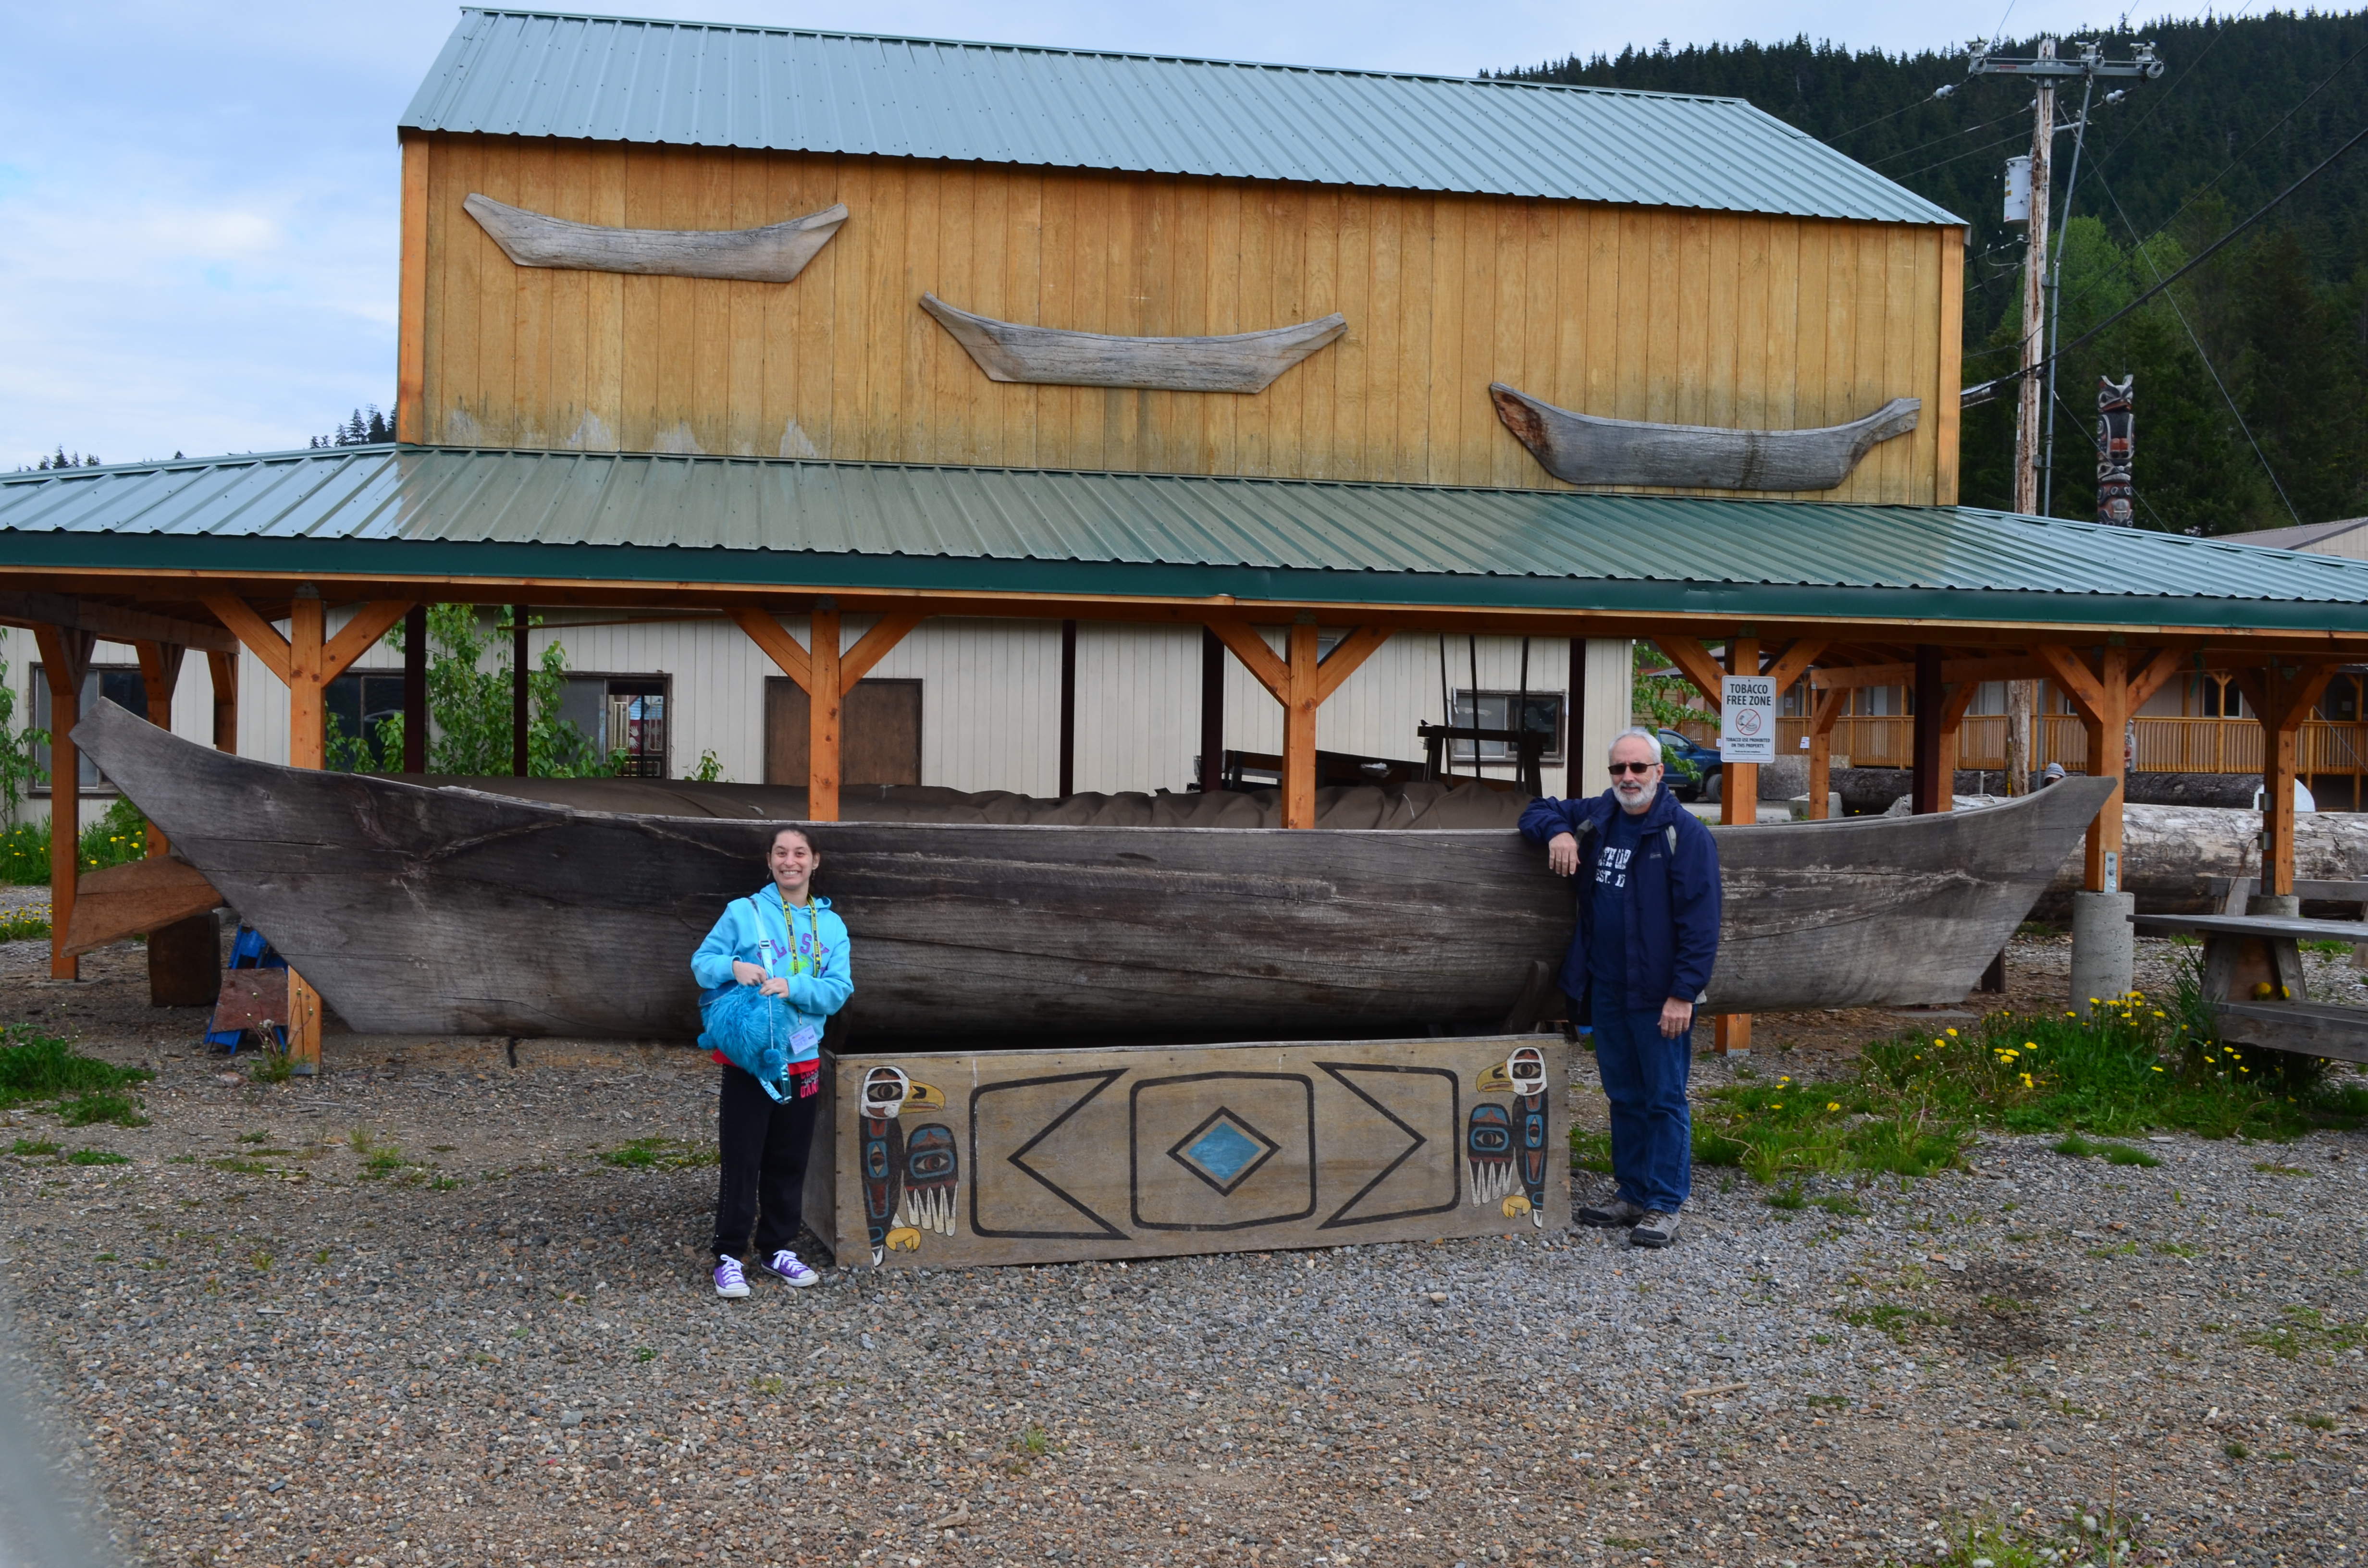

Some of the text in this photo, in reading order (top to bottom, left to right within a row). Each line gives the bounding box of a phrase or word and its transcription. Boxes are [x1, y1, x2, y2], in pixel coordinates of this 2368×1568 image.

[1730, 684, 1768, 694] TOBACCO
[1727, 695, 1771, 706] FREE ZONE
